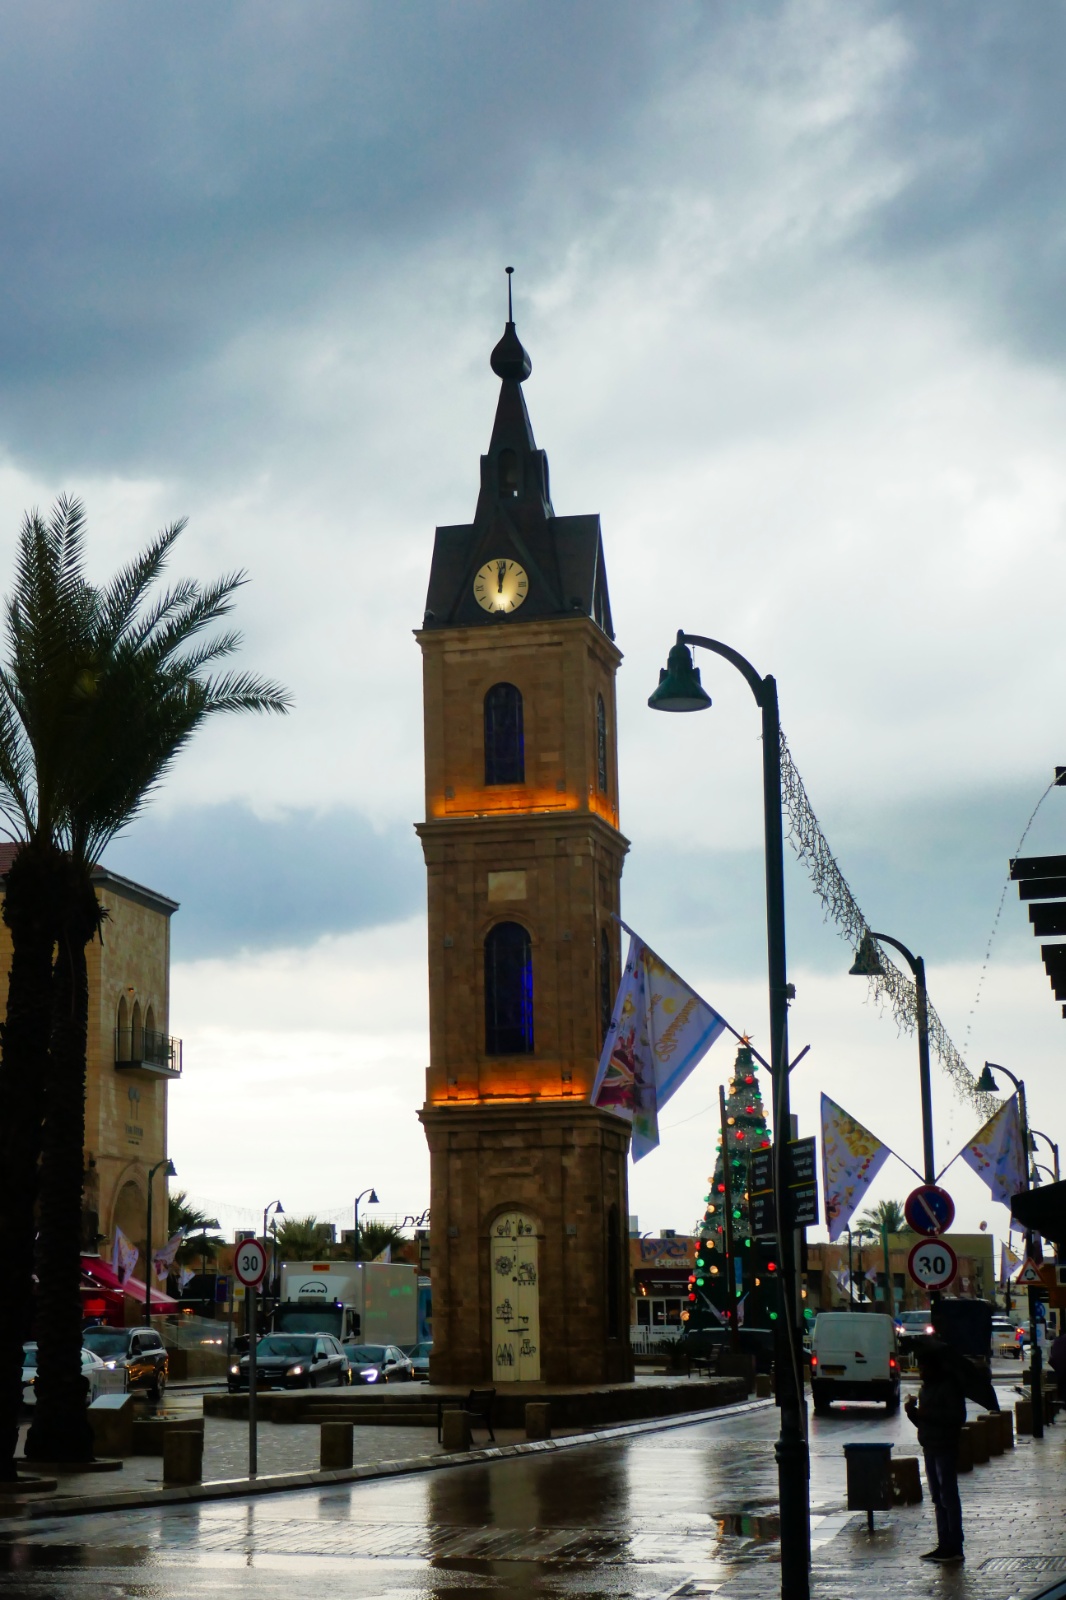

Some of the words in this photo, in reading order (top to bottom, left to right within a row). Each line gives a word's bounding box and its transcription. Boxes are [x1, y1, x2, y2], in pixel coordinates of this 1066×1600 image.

[242, 1255, 258, 1271] 30
[654, 1258, 691, 1268] Express
[919, 1256, 946, 1274] 30
